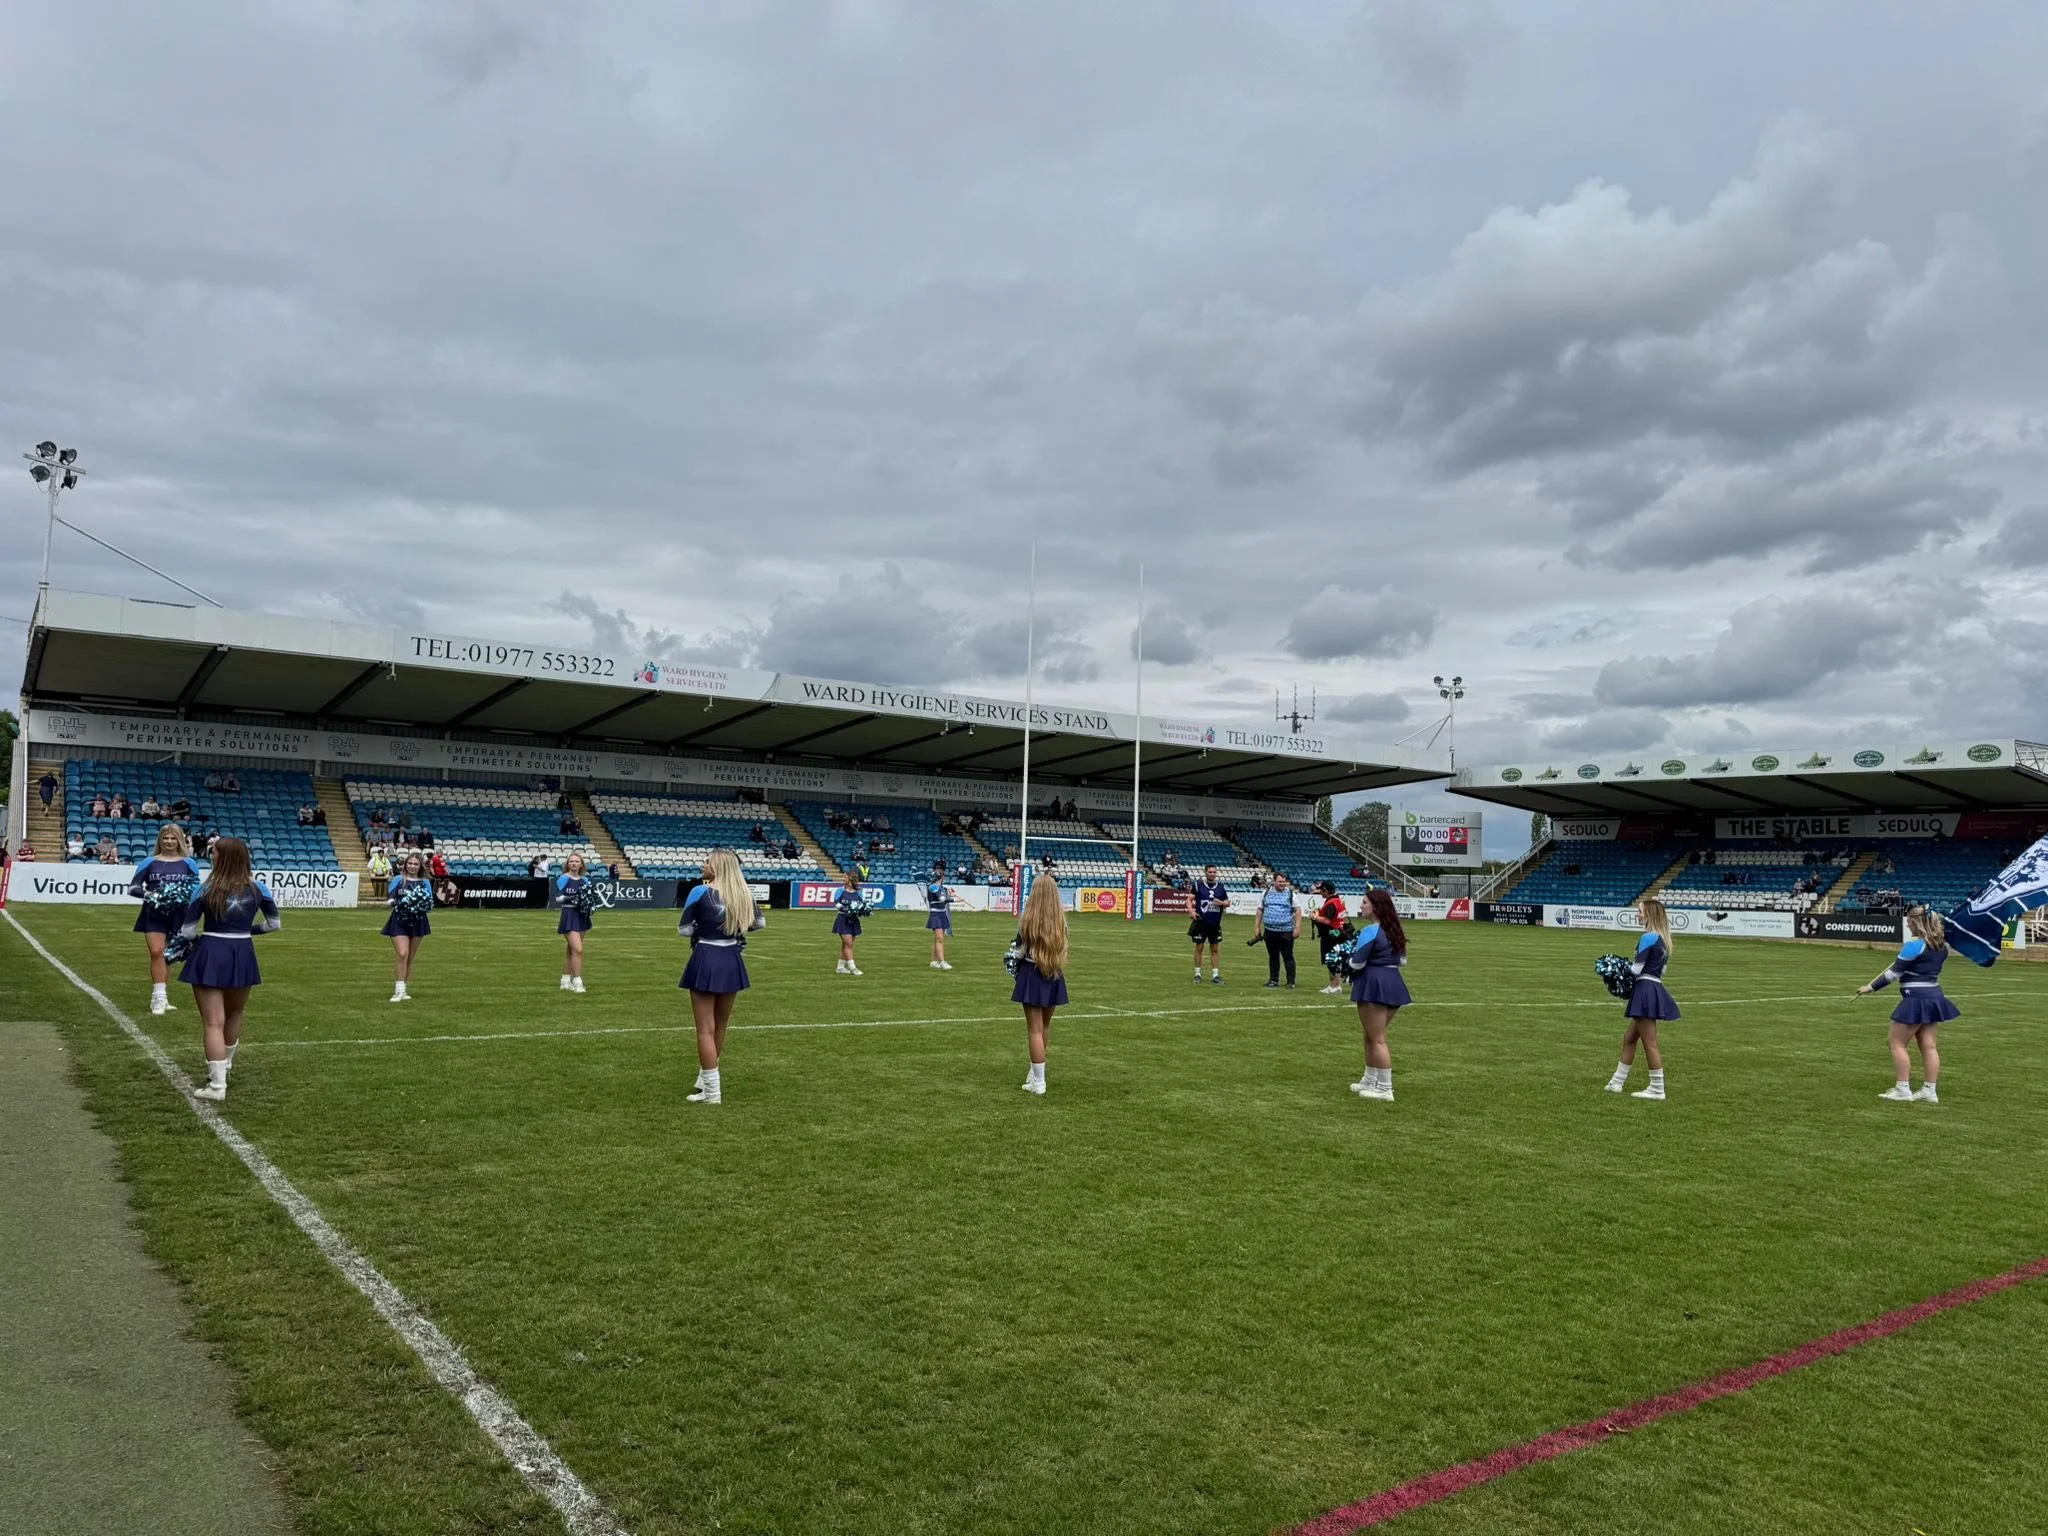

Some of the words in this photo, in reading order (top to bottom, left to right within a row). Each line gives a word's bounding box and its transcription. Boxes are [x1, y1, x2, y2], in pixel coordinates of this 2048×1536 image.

[411, 636, 534, 668] TEL:01977
[541, 652, 614, 677] 553322
[662, 665, 688, 677] WARD
[690, 669, 729, 681] HYGIENE
[665, 677, 709, 690] SERVICES
[708, 681, 726, 691] LTD
[803, 683, 865, 703] WARD
[872, 690, 958, 714] HYGIENE
[964, 702, 1048, 725] SERVICES
[1053, 712, 1108, 730] STAND
[110, 721, 200, 737] TEMPORARY
[207, 728, 216, 737] &
[224, 729, 309, 743] PERMANENT
[126, 733, 212, 748] PERIMETER
[220, 739, 299, 753] SOLUTIONS
[1287, 737, 1323, 753] 553322
[439, 744, 511, 758] TEMPORARY
[517, 751, 524, 759] &
[530, 751, 600, 764] PERMANENT
[452, 756, 521, 768] PERIMETER
[527, 761, 591, 772] SOLUTIONS
[703, 763, 761, 776] TEMPORARY
[776, 769, 831, 780] PERMANENT
[713, 773, 769, 784] PERIMETER
[773, 777, 825, 788] SOLUTIONS
[923, 787, 968, 797] PERIMETER
[971, 790, 1014, 800] SOLUTIONS
[1420, 815, 1465, 825] bartercard
[1728, 820, 1766, 835] THE
[1772, 818, 1850, 836] STABLE
[1878, 819, 1943, 833] SEDULO
[1420, 830, 1433, 839] 00
[1436, 830, 1449, 839] 00
[1563, 824, 1609, 836] SEDULO
[1423, 857, 1459, 865] bartercard
[34, 877, 78, 894] Vico
[83, 879, 130, 895] Hom
[271, 872, 347, 889] RACING?
[290, 889, 328, 900] JAYNE
[464, 889, 527, 898] CONSTRUCTION
[615, 882, 653, 899] keat
[803, 886, 884, 903] BETED
[1083, 892, 1096, 904] BB
[1825, 922, 1895, 934] CONSTRUCTION
